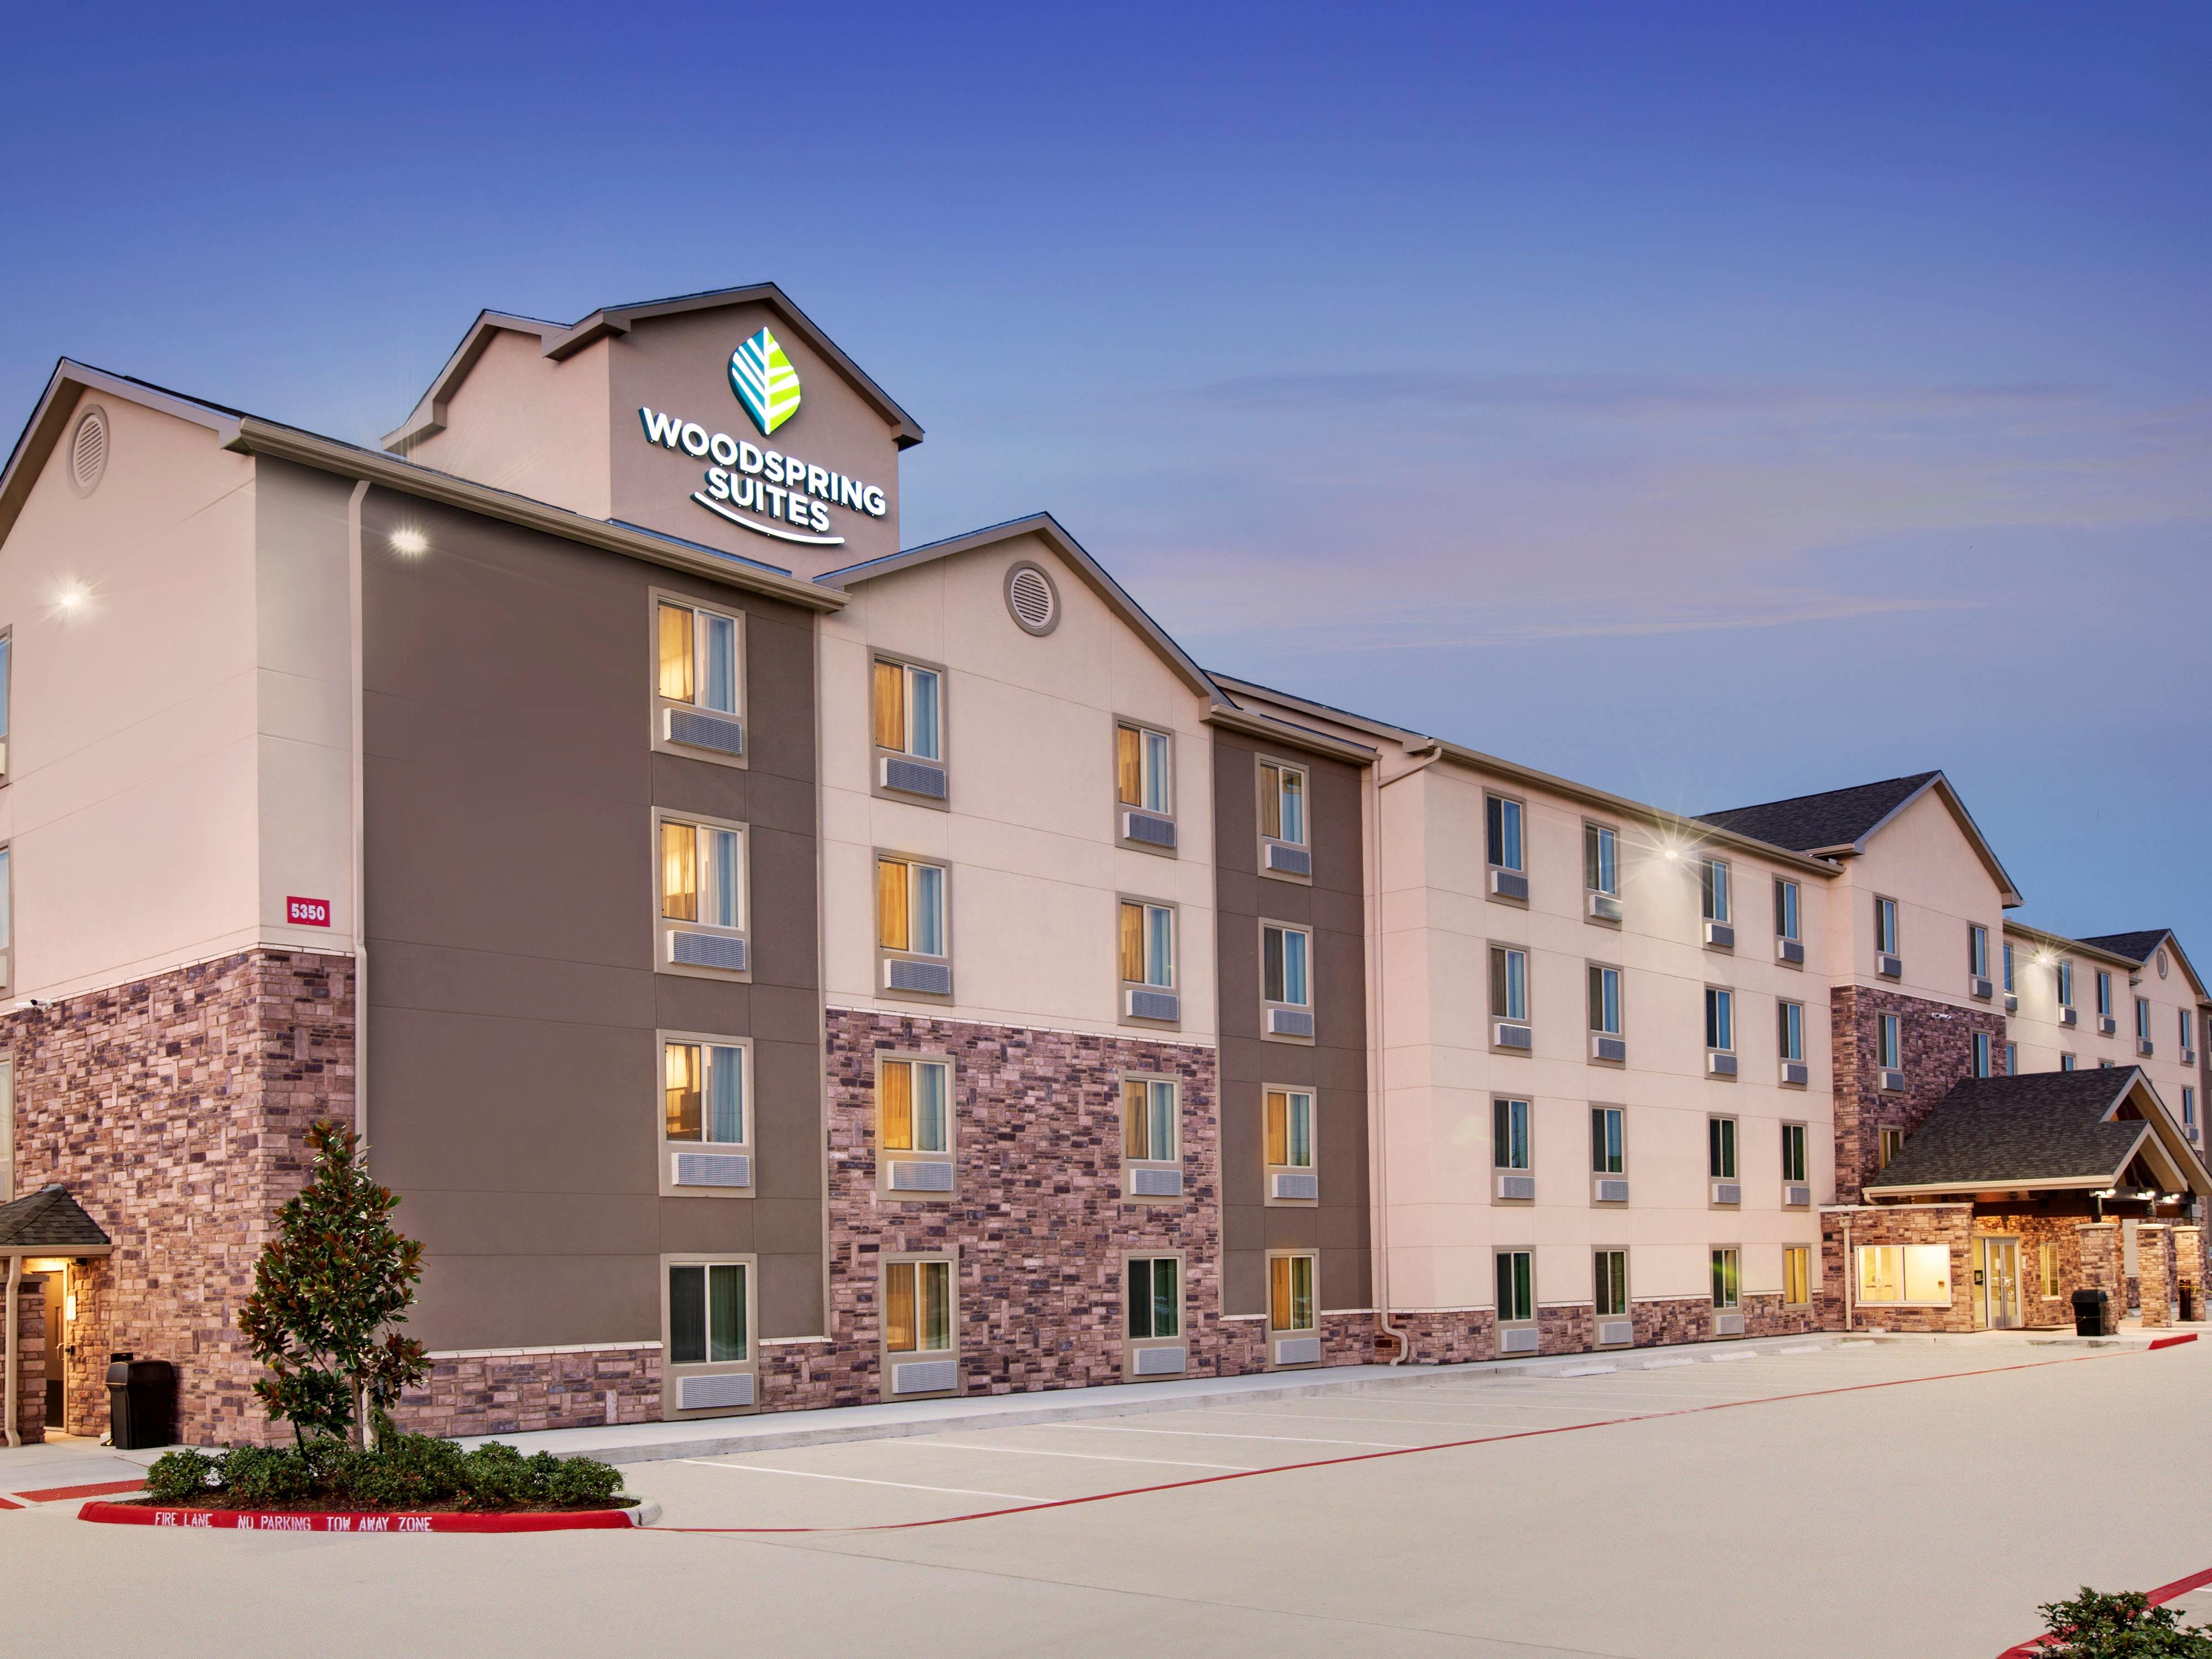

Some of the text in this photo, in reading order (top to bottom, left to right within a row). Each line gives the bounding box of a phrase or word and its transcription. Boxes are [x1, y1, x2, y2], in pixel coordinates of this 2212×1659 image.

[639, 406, 886, 516] WOODSPRING
[706, 467, 830, 532] SUITES
[291, 902, 325, 921] 5350
[155, 1511, 434, 1532] FIRE LANE NO PARKING TOW AWAY ZONE
